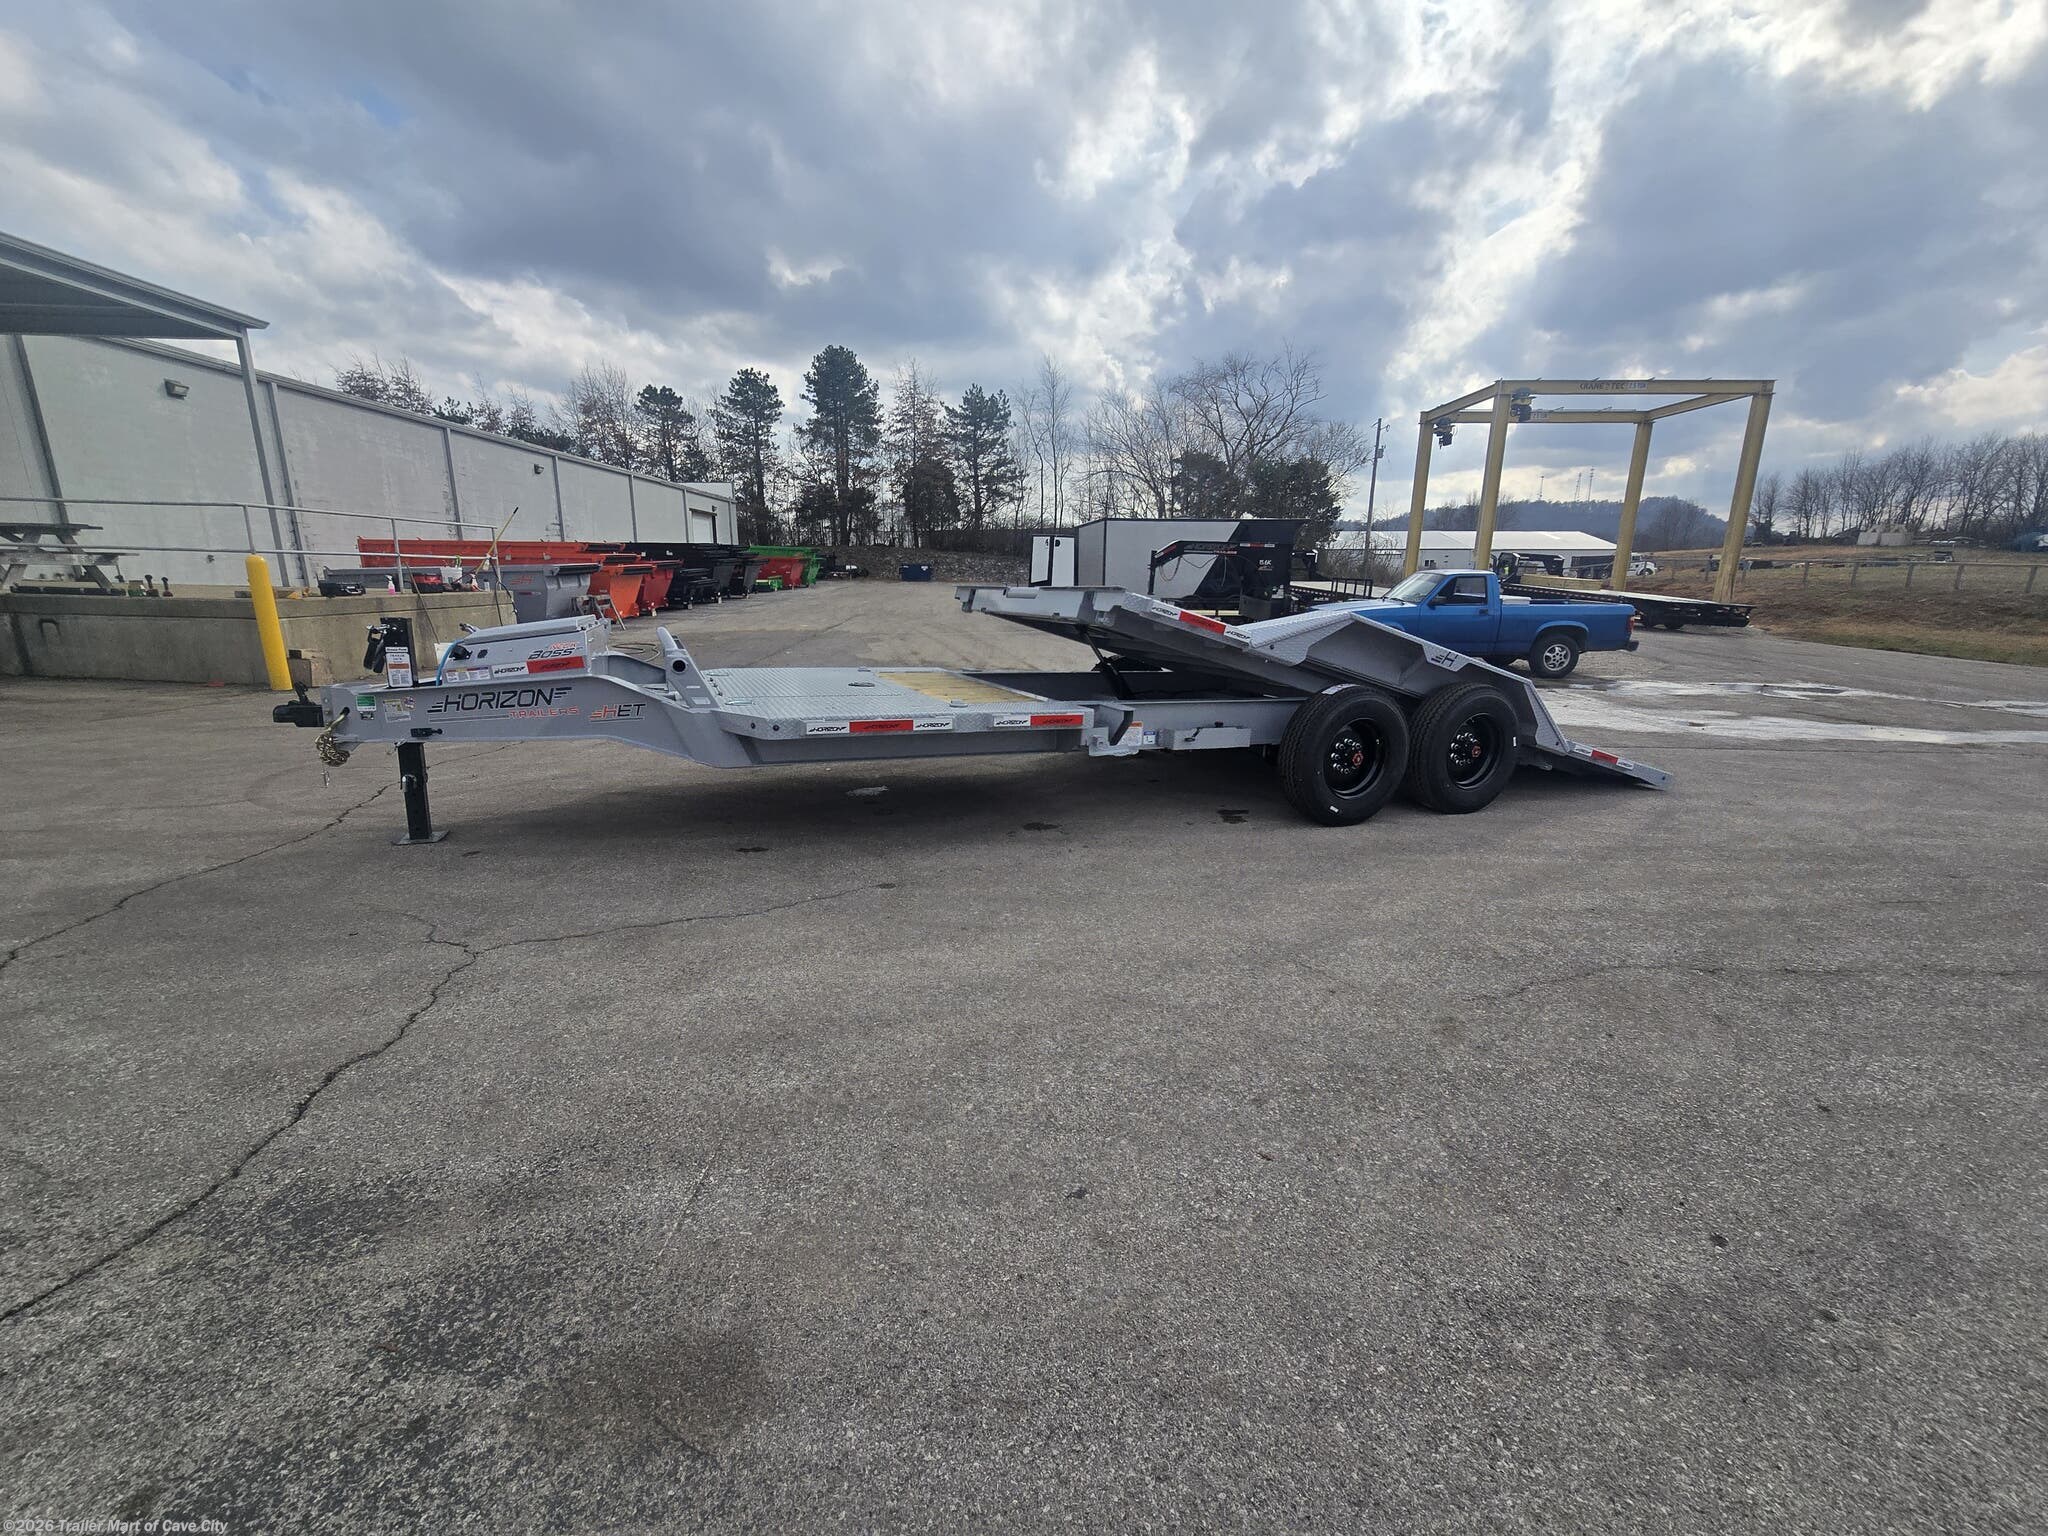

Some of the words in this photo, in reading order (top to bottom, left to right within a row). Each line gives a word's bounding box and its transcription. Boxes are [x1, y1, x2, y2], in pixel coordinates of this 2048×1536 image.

[428, 686, 571, 714] HORIZON
[509, 706, 579, 718] TRAILERS
[591, 703, 645, 719] HET
